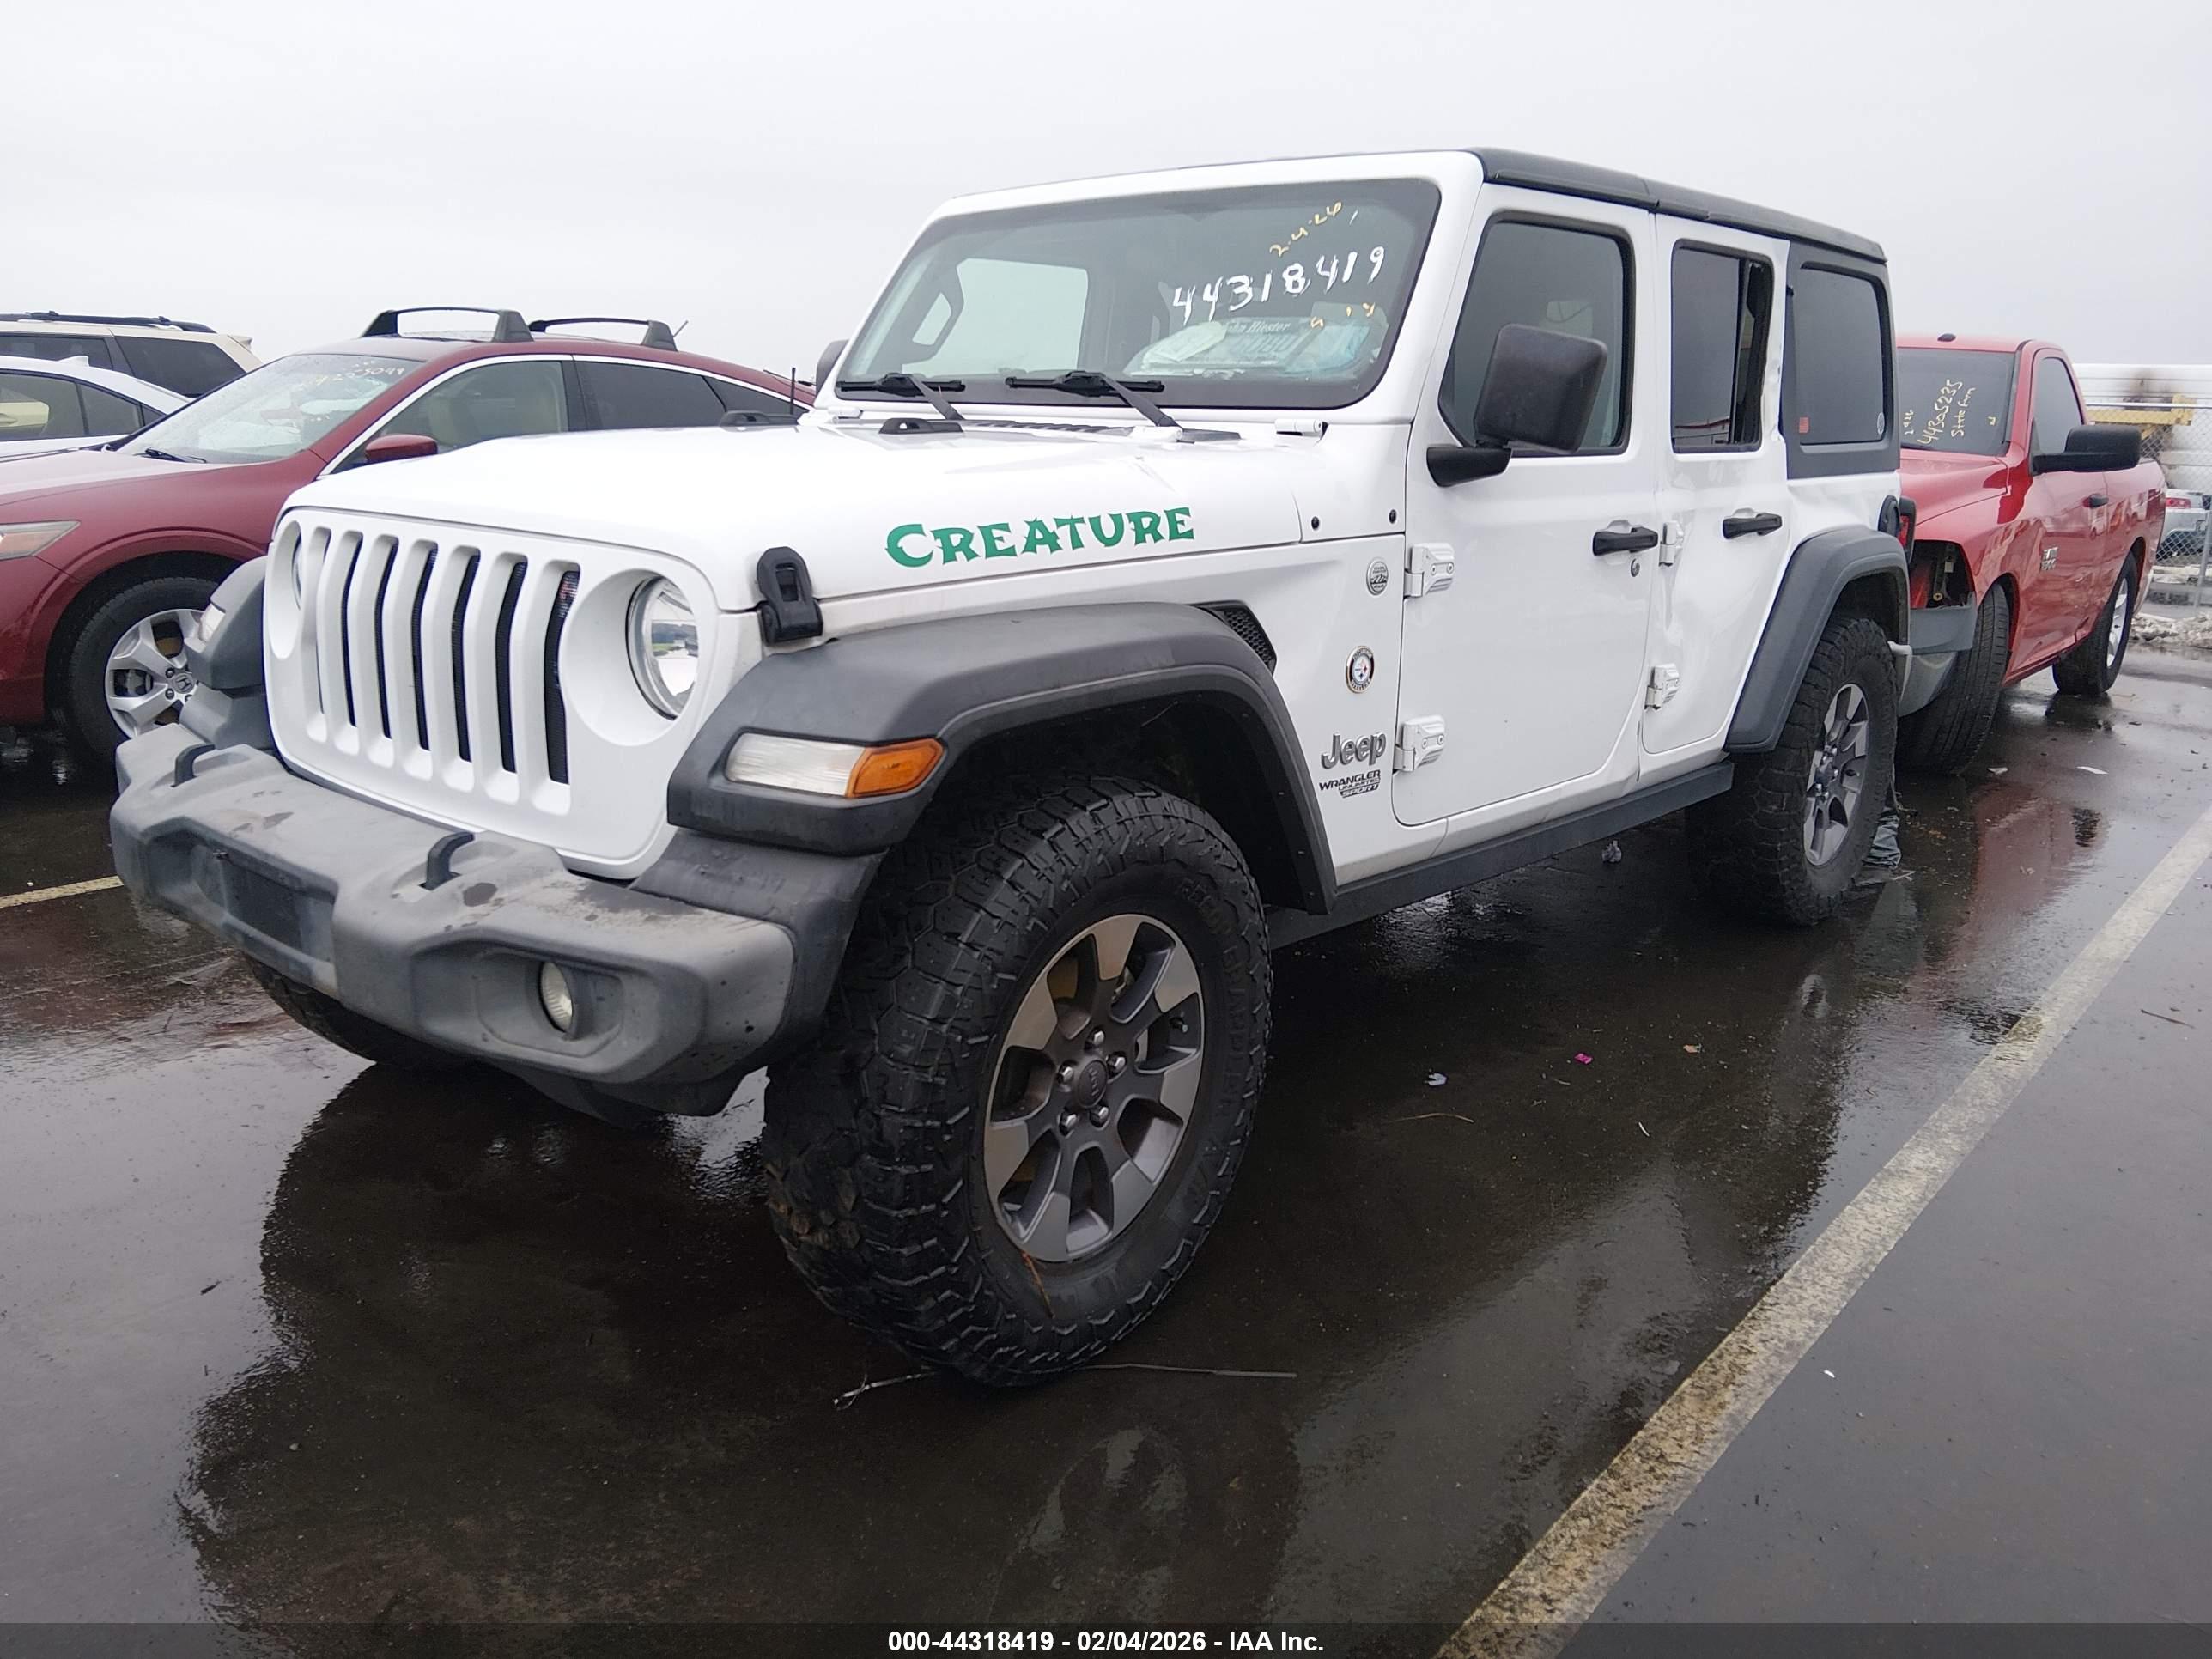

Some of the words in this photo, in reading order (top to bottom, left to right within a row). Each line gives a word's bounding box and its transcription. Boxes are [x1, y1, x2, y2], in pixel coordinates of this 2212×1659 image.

[1172, 246, 1385, 326] 44318419
[1320, 732, 1388, 770] Jeep
[1318, 769, 1382, 791] WRANGLER
